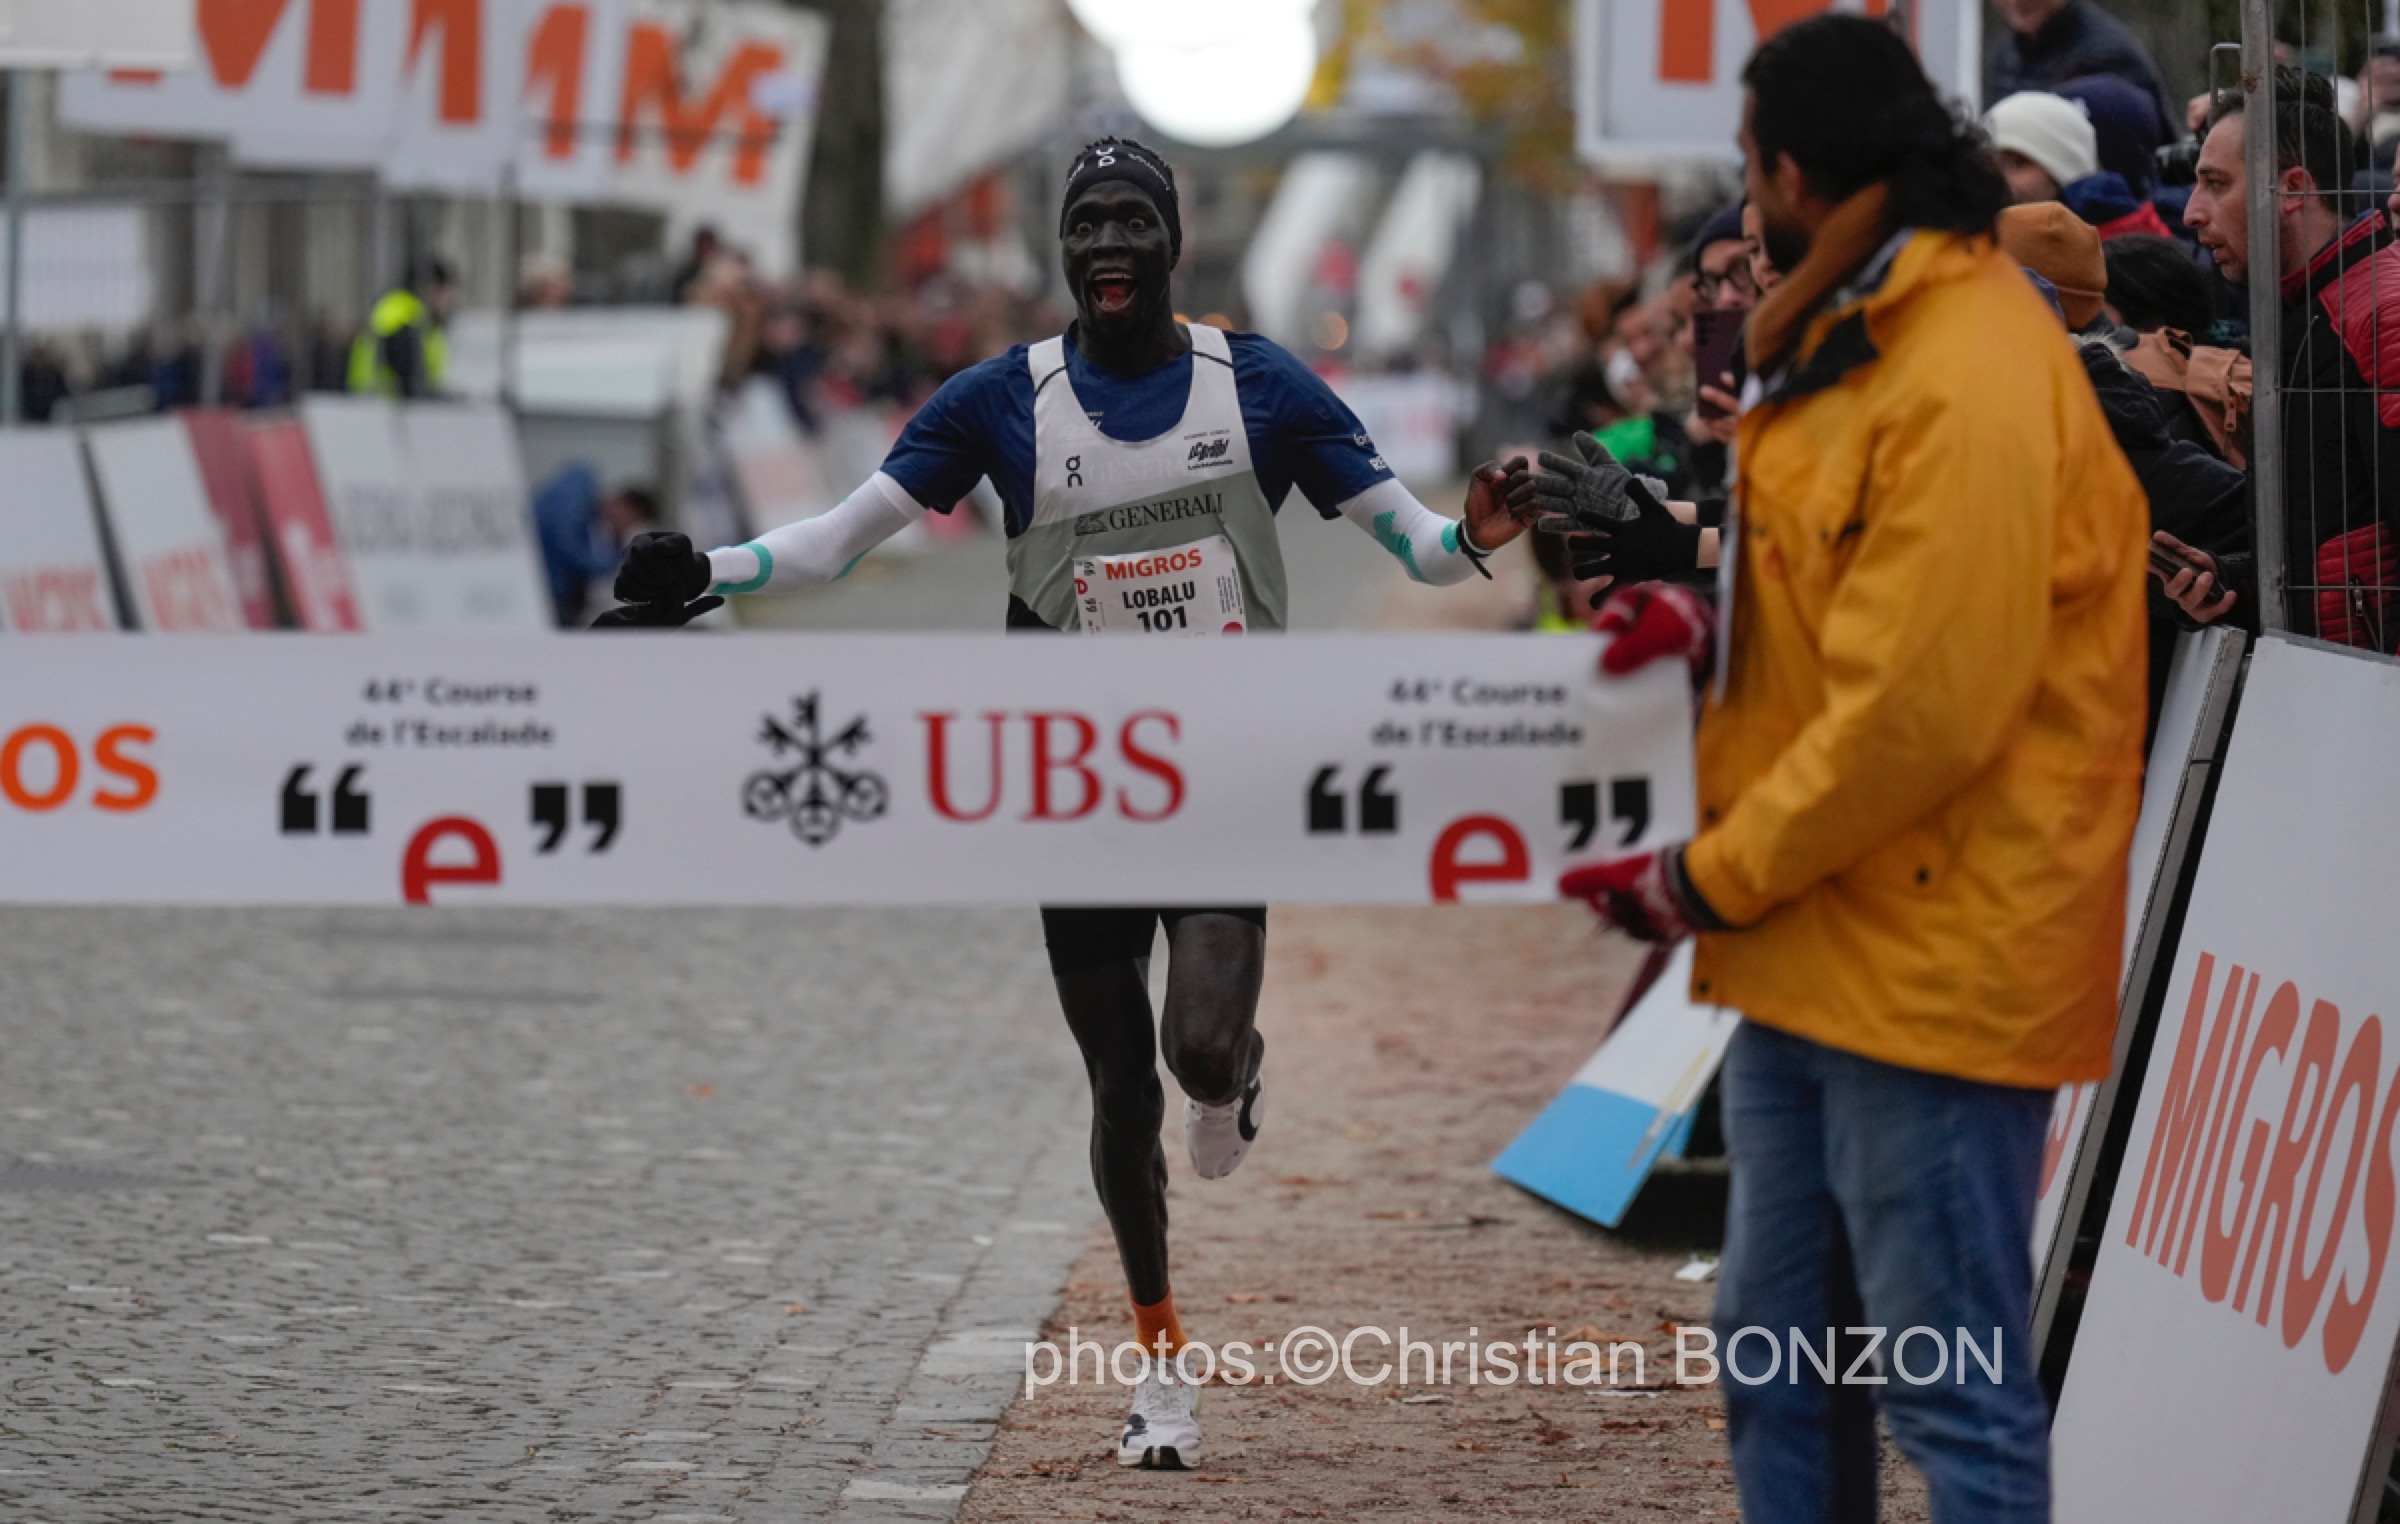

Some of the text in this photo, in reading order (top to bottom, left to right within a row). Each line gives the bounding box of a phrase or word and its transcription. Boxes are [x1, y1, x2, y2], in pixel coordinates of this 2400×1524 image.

[1109, 493, 1223, 530] GENERALI
[1105, 549, 1203, 580] MIGROS
[1122, 581, 1196, 609] LOBALU
[1137, 606, 1188, 633] 101
[423, 680, 539, 704] Course
[1451, 680, 1567, 705] Course
[346, 717, 383, 746] de
[1371, 720, 1411, 747] de
[916, 708, 1186, 823] UBS
[2125, 952, 2400, 1374] MIGROS
